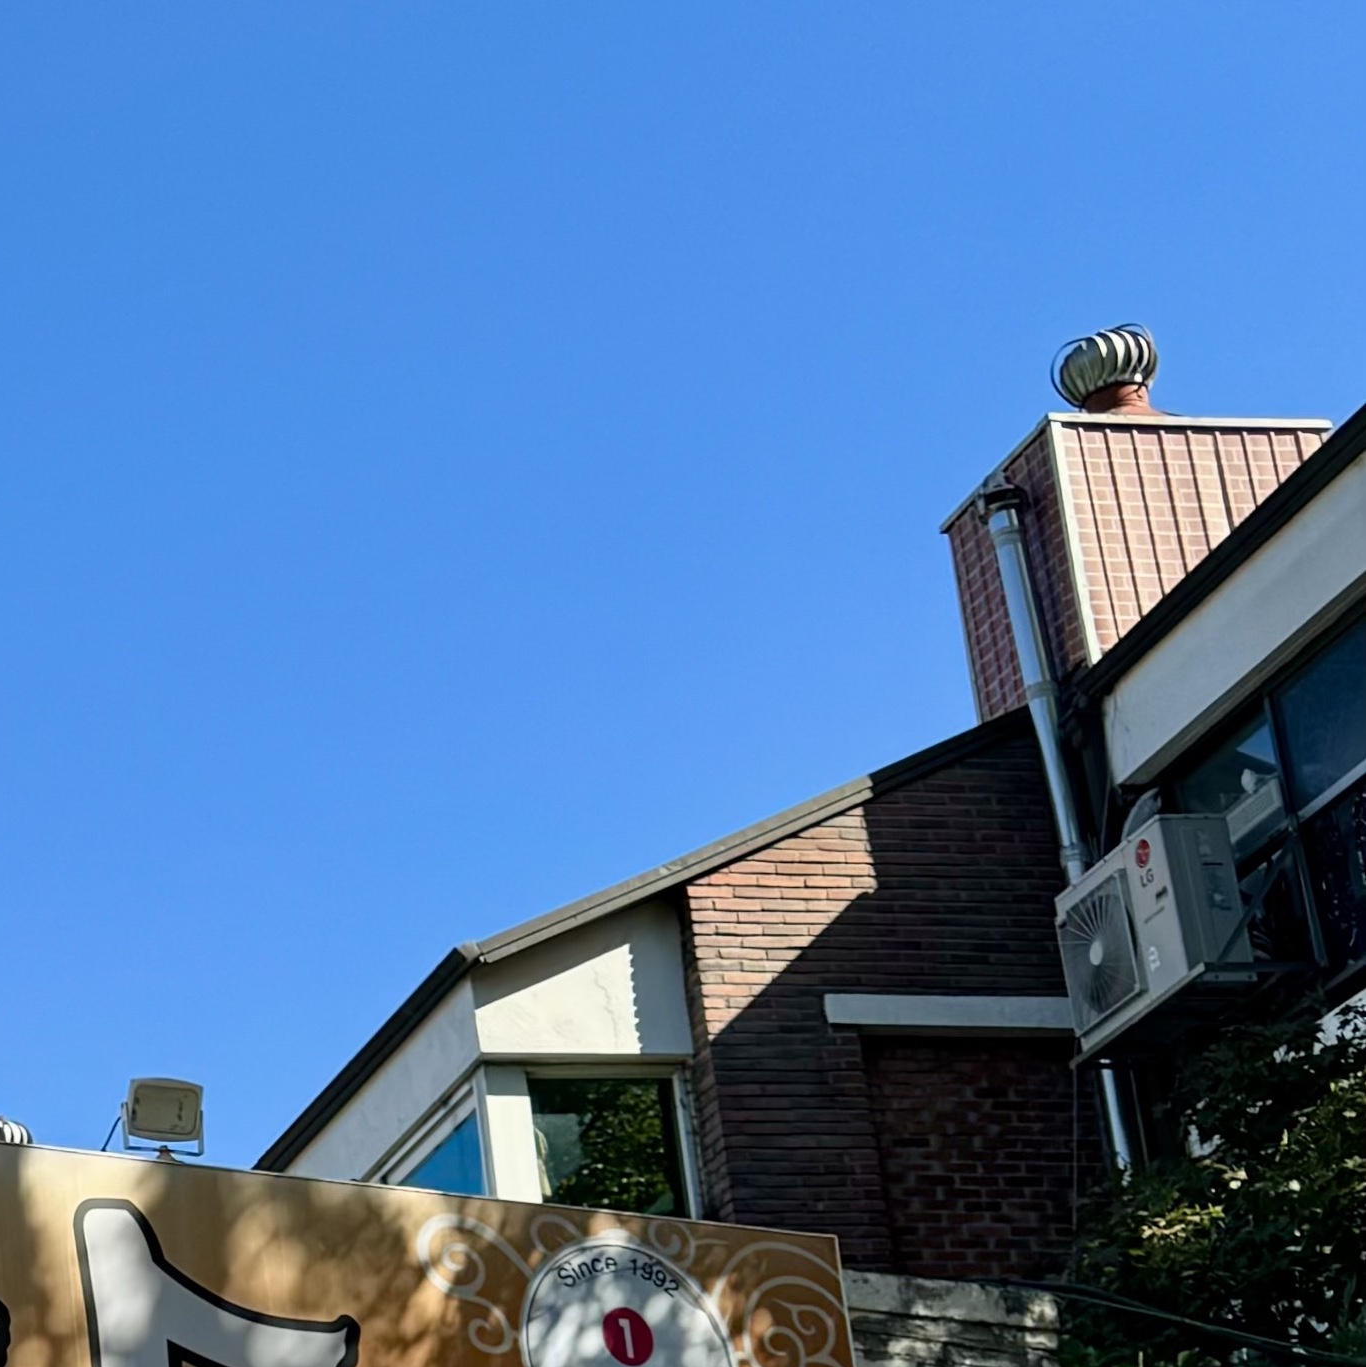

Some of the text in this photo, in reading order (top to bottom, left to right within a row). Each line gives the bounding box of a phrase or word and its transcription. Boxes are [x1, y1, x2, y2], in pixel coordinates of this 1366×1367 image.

[1140, 867, 1155, 888] LG
[557, 1255, 681, 1298] Since 1992
[617, 1317, 636, 1360] 1
